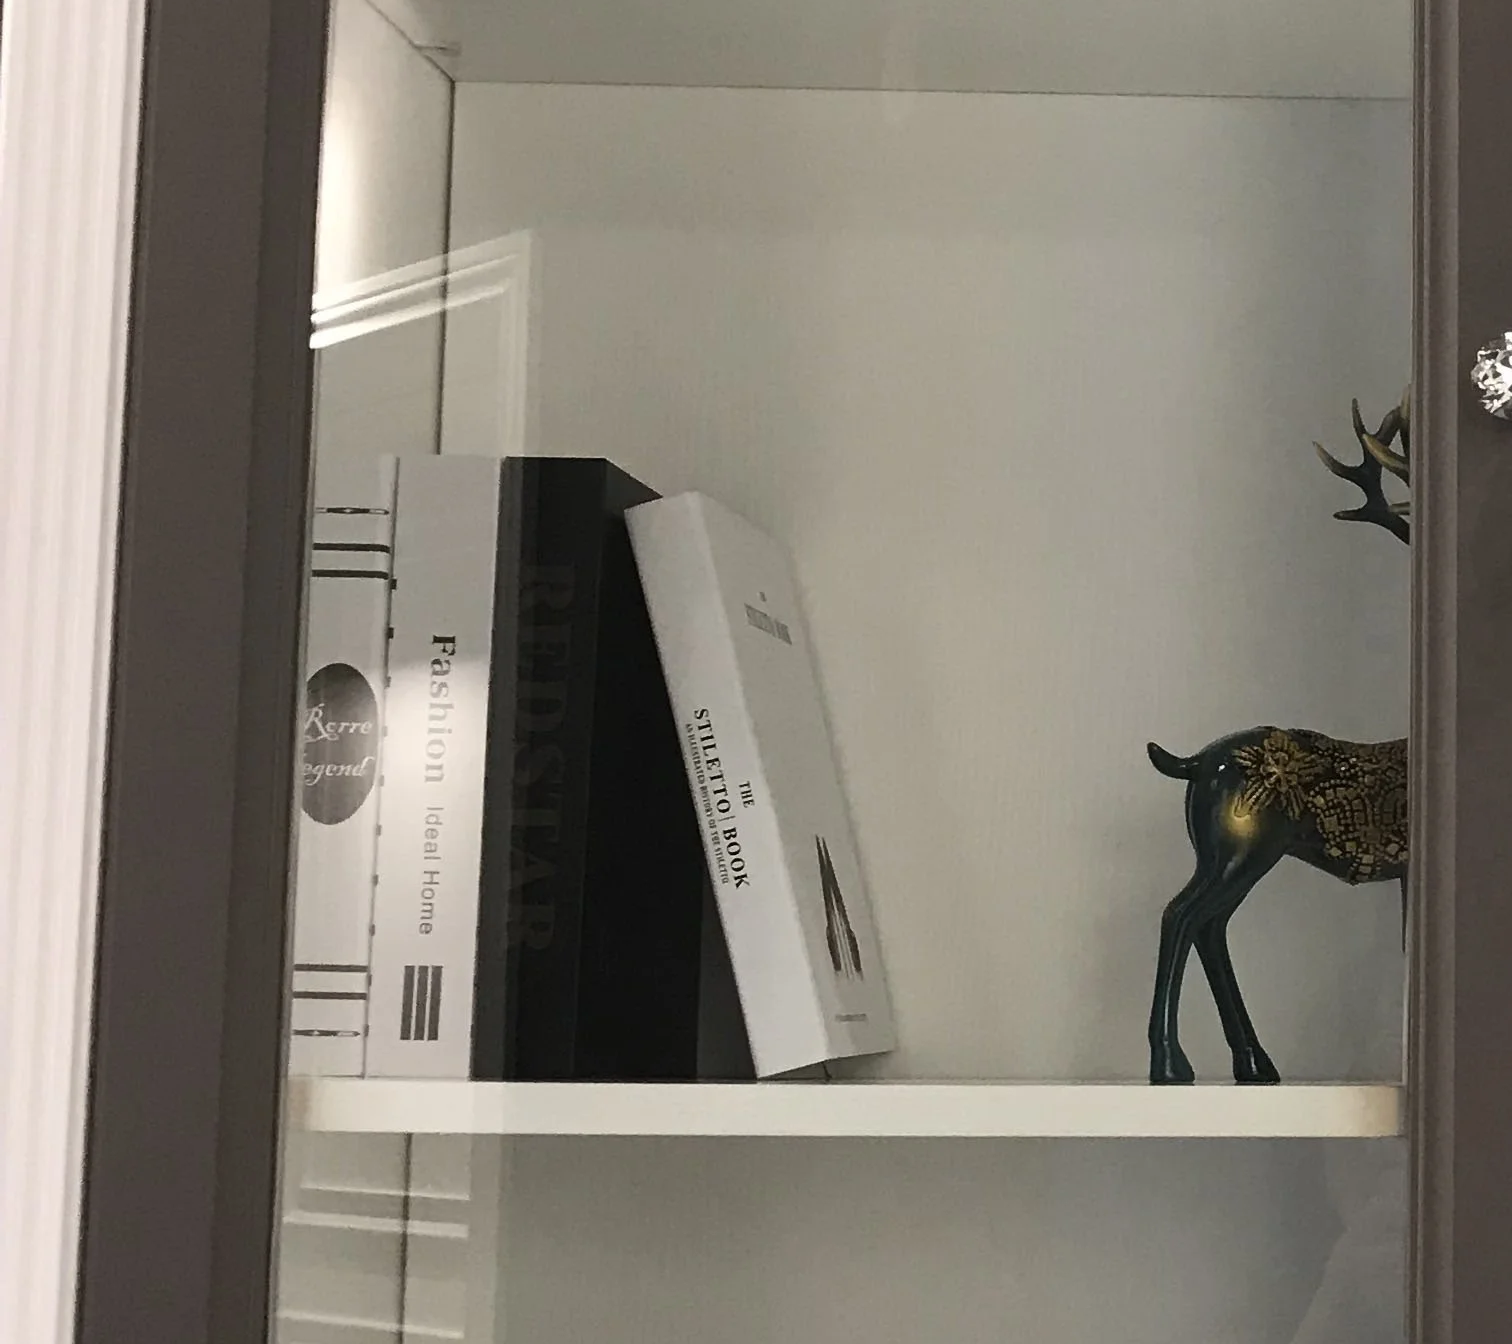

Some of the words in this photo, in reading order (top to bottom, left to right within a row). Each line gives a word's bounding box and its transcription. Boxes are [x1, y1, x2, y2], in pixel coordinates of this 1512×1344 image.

[424, 635, 456, 783] Fashion
[303, 755, 375, 786] egend
[694, 708, 731, 814] STILETTO
[722, 827, 750, 890] BOOK
[739, 781, 755, 808] THE
[423, 806, 444, 860] Ideal
[418, 870, 440, 936] Home
